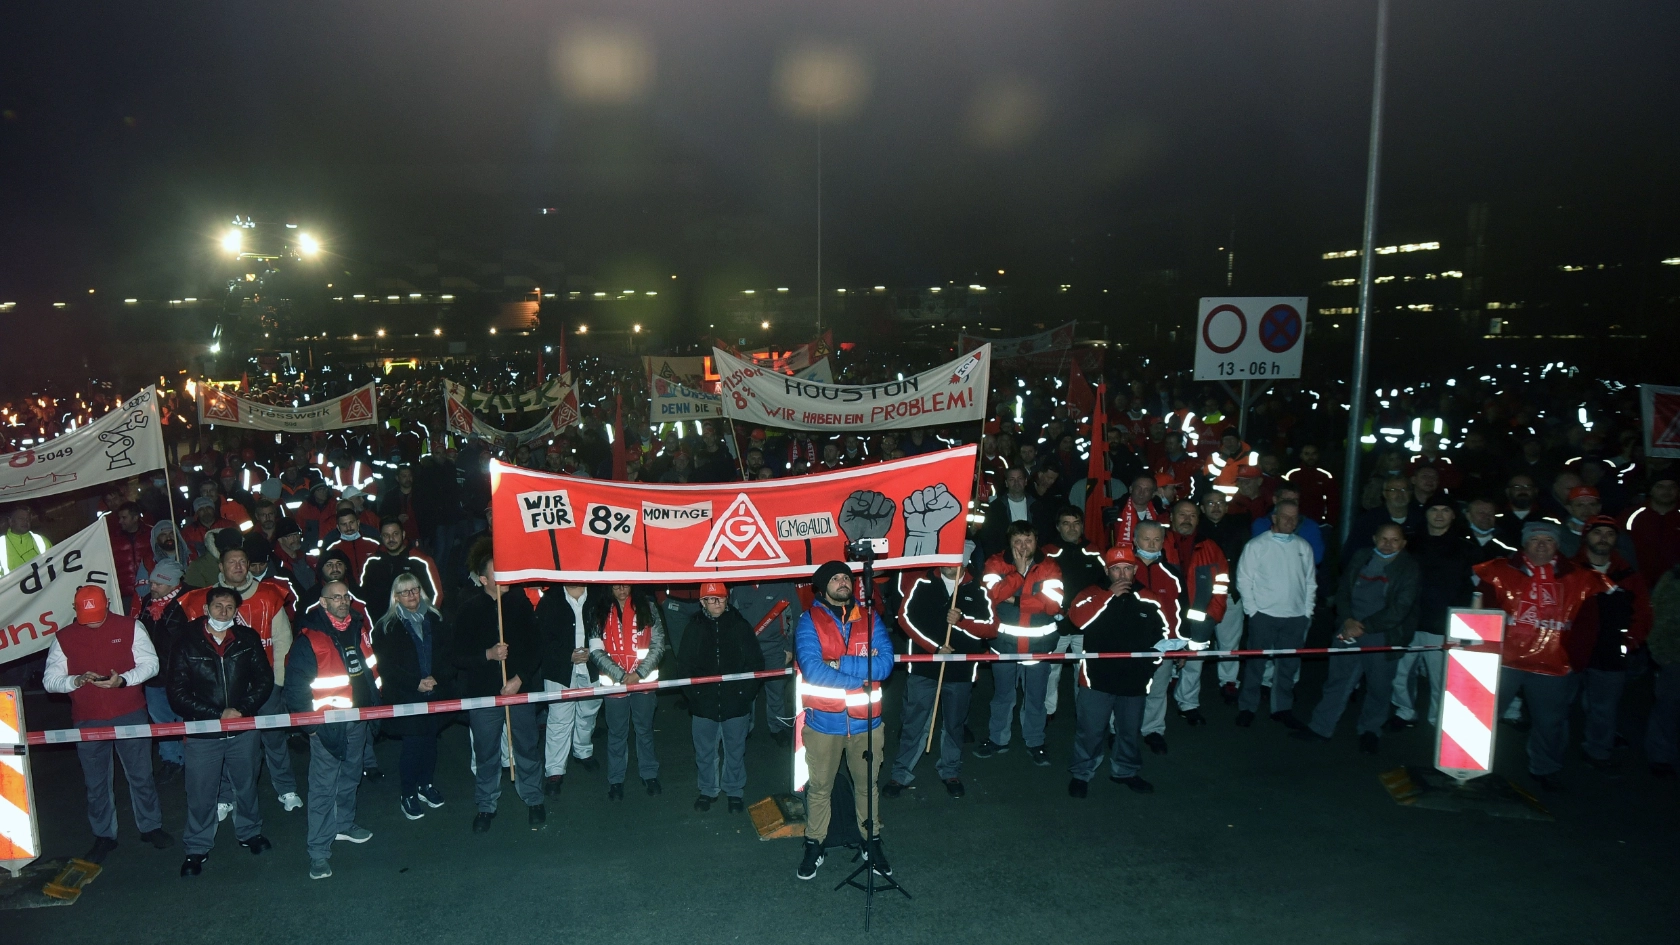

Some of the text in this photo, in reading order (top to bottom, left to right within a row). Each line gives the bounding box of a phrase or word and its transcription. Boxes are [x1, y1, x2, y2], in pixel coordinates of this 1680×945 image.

[1217, 361, 1235, 376] 13
[1249, 361, 1267, 376] 06
[1271, 361, 1281, 376] h
[784, 376, 919, 403] HOUSTON
[248, 405, 331, 420] Presswerk
[661, 402, 691, 415] DENN
[694, 403, 710, 413] DIE
[761, 386, 974, 425] WIR HABEN EIN PROBLEM!
[523, 494, 565, 510] WIR
[531, 507, 572, 528] FÜR
[588, 505, 631, 535] 8%
[642, 507, 710, 522] MONTAGE
[19, 549, 84, 595] die
